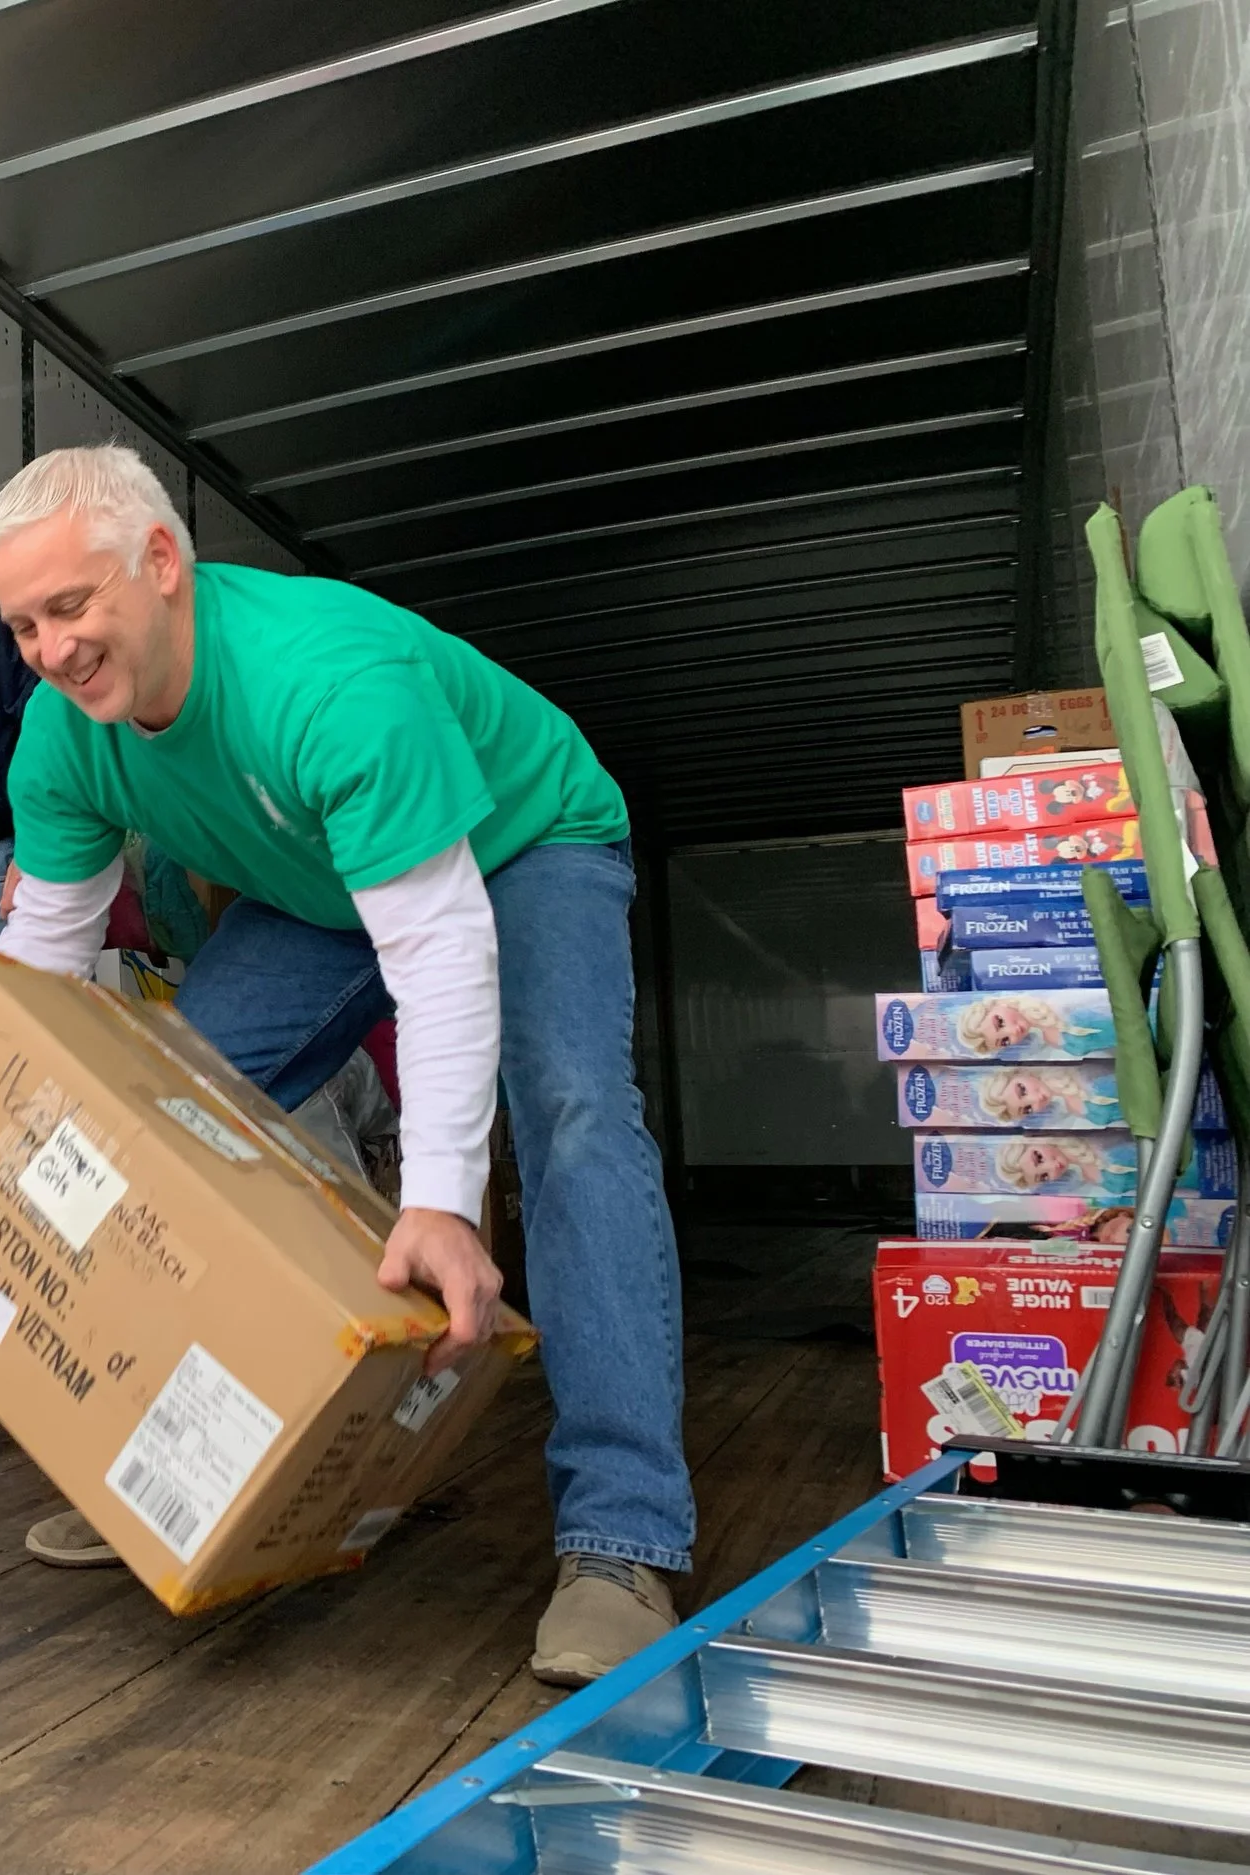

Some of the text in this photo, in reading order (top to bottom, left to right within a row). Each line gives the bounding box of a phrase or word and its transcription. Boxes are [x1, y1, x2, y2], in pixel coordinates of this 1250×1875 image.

[991, 706, 1007, 718] 24
[1059, 696, 1093, 710] EGGS
[972, 787, 986, 825] DELUXE
[1009, 789, 1023, 815] PLAY
[1021, 778, 1038, 822] GIFT SET
[1025, 833, 1038, 852] SET
[990, 845, 1003, 868] EAD
[950, 881, 1011, 896] FROZEN
[965, 919, 1028, 935] FROZEN
[987, 962, 1051, 978] FROZEN
[892, 1006, 906, 1047] FROZEN
[914, 1073, 928, 1114] FROZEN
[56, 1123, 97, 1183] Women
[930, 1139, 944, 1180] FROZEN
[37, 1155, 69, 1198] Girls
[135, 1203, 169, 1236] AAC
[136, 1228, 187, 1284] BEACH
[1008, 1255, 1122, 1268] HUGGIES
[1006, 1278, 1073, 1293] VALUE
[892, 1287, 919, 1318] 4
[925, 1295, 951, 1305] 120
[1012, 1293, 1071, 1309] HUGE
[15, 1302, 97, 1404] VIETNAM
[966, 1339, 1050, 1350] FITTING DIAPER
[106, 1351, 137, 1383] of
[980, 1367, 1075, 1392] move
